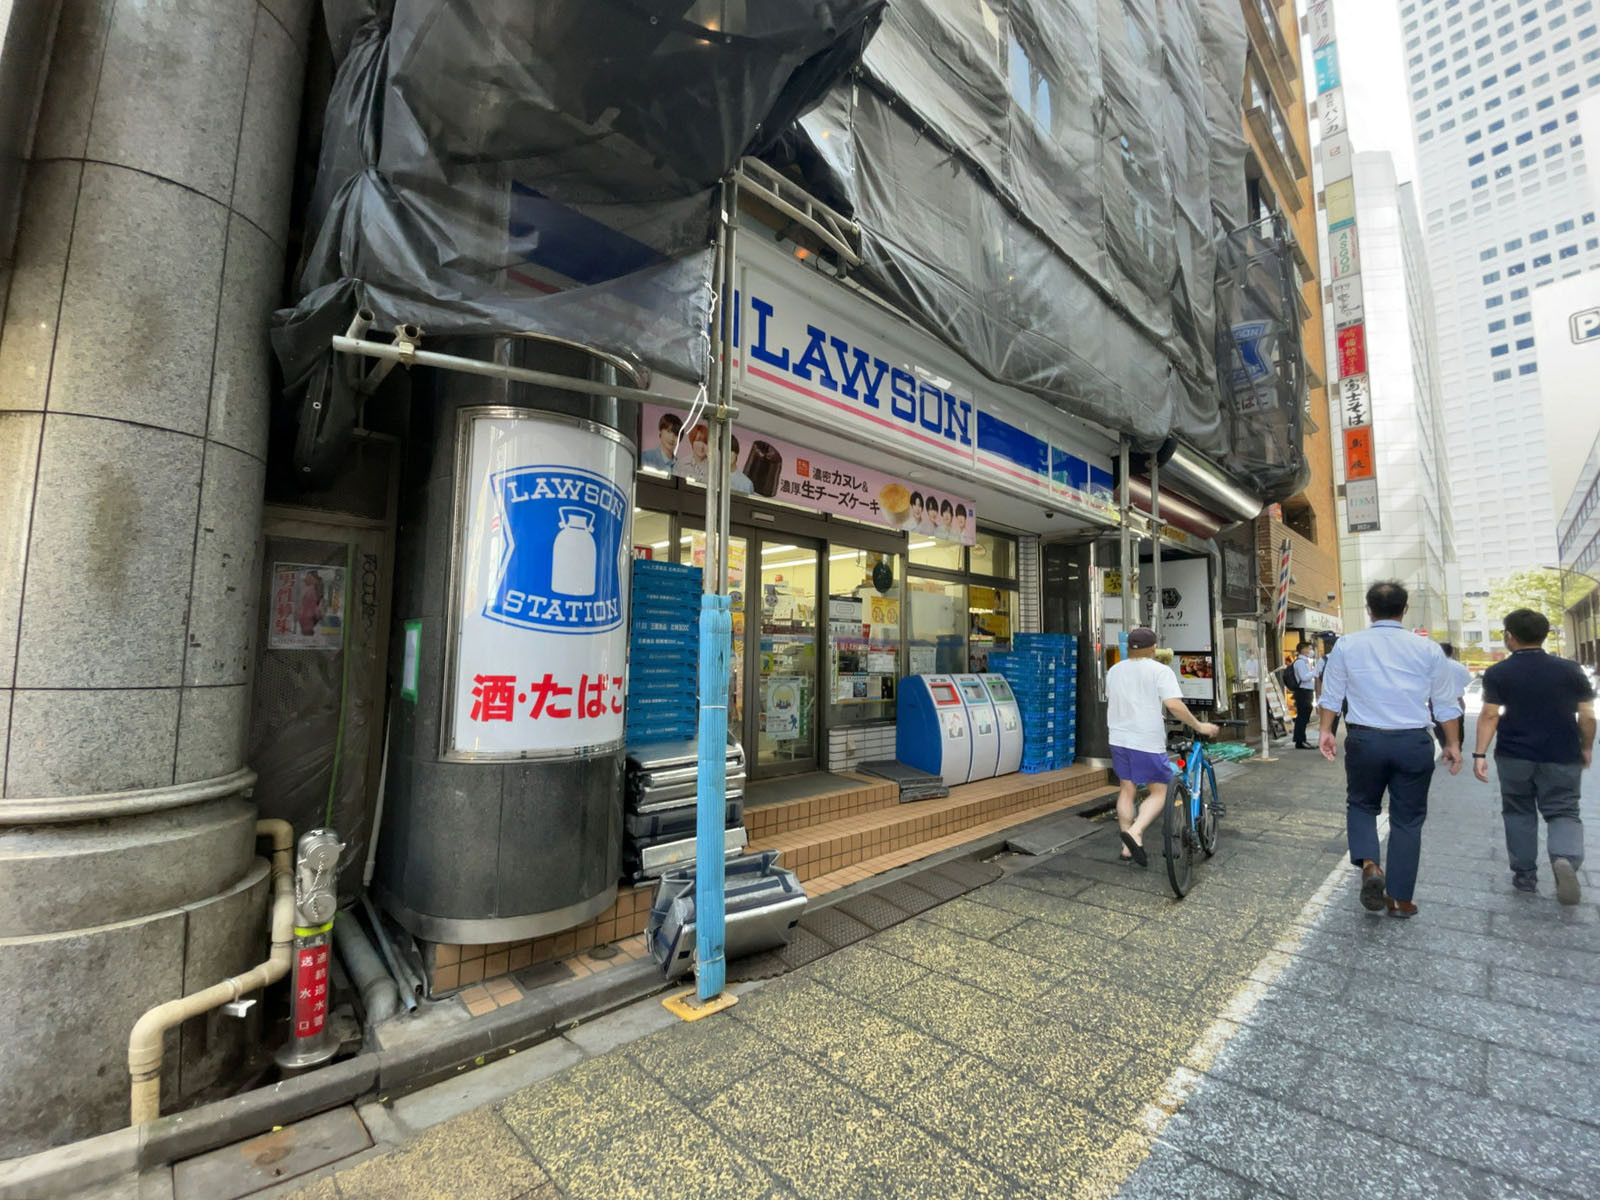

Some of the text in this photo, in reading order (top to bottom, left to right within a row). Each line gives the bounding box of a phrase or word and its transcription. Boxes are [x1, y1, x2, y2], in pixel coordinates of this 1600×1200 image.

[751, 296, 973, 447] LAWSON
[507, 477, 623, 521] LAWSON
[780, 479, 880, 515] 濃厚生チーズケーキ
[502, 590, 618, 622] STATION
[299, 955, 313, 1031] 送水口
